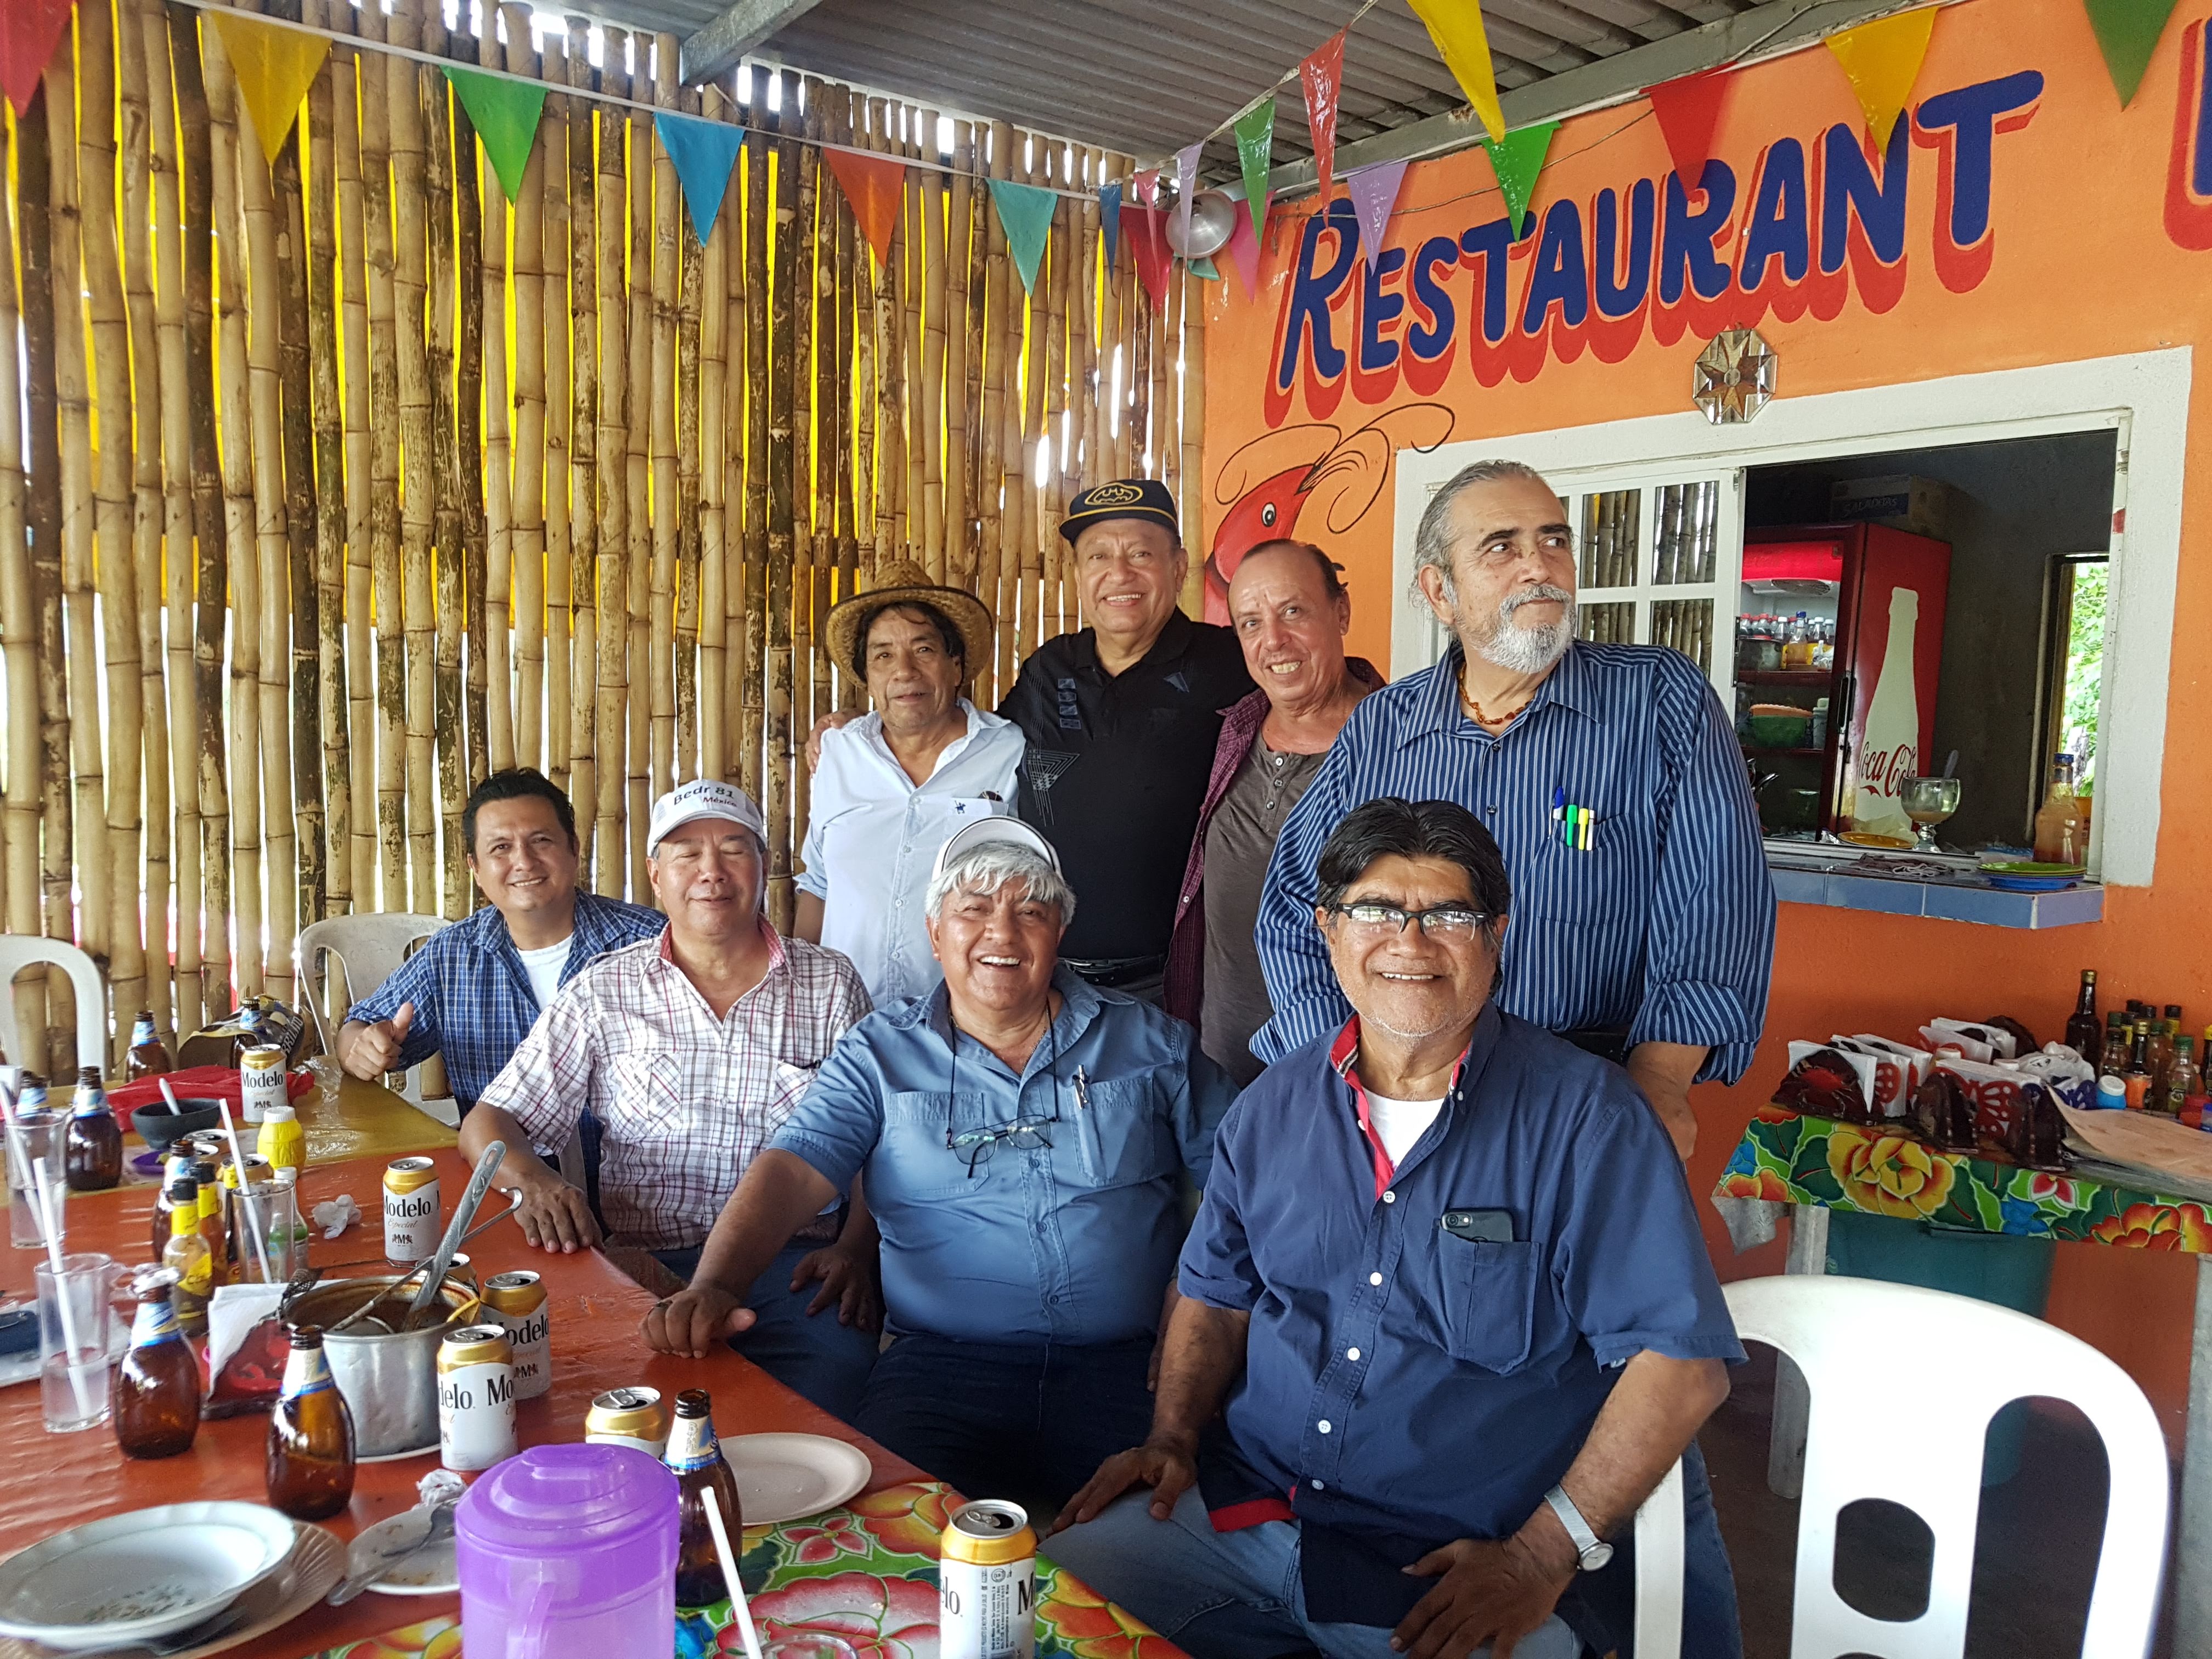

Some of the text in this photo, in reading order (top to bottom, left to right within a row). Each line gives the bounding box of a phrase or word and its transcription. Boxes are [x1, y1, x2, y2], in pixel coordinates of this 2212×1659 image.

[1265, 69, 2043, 427] RESTAURANT
[703, 797, 737, 807] México
[715, 787, 734, 799] 81
[242, 1070, 284, 1088] Modelo
[488, 1314, 549, 1346] odelo
